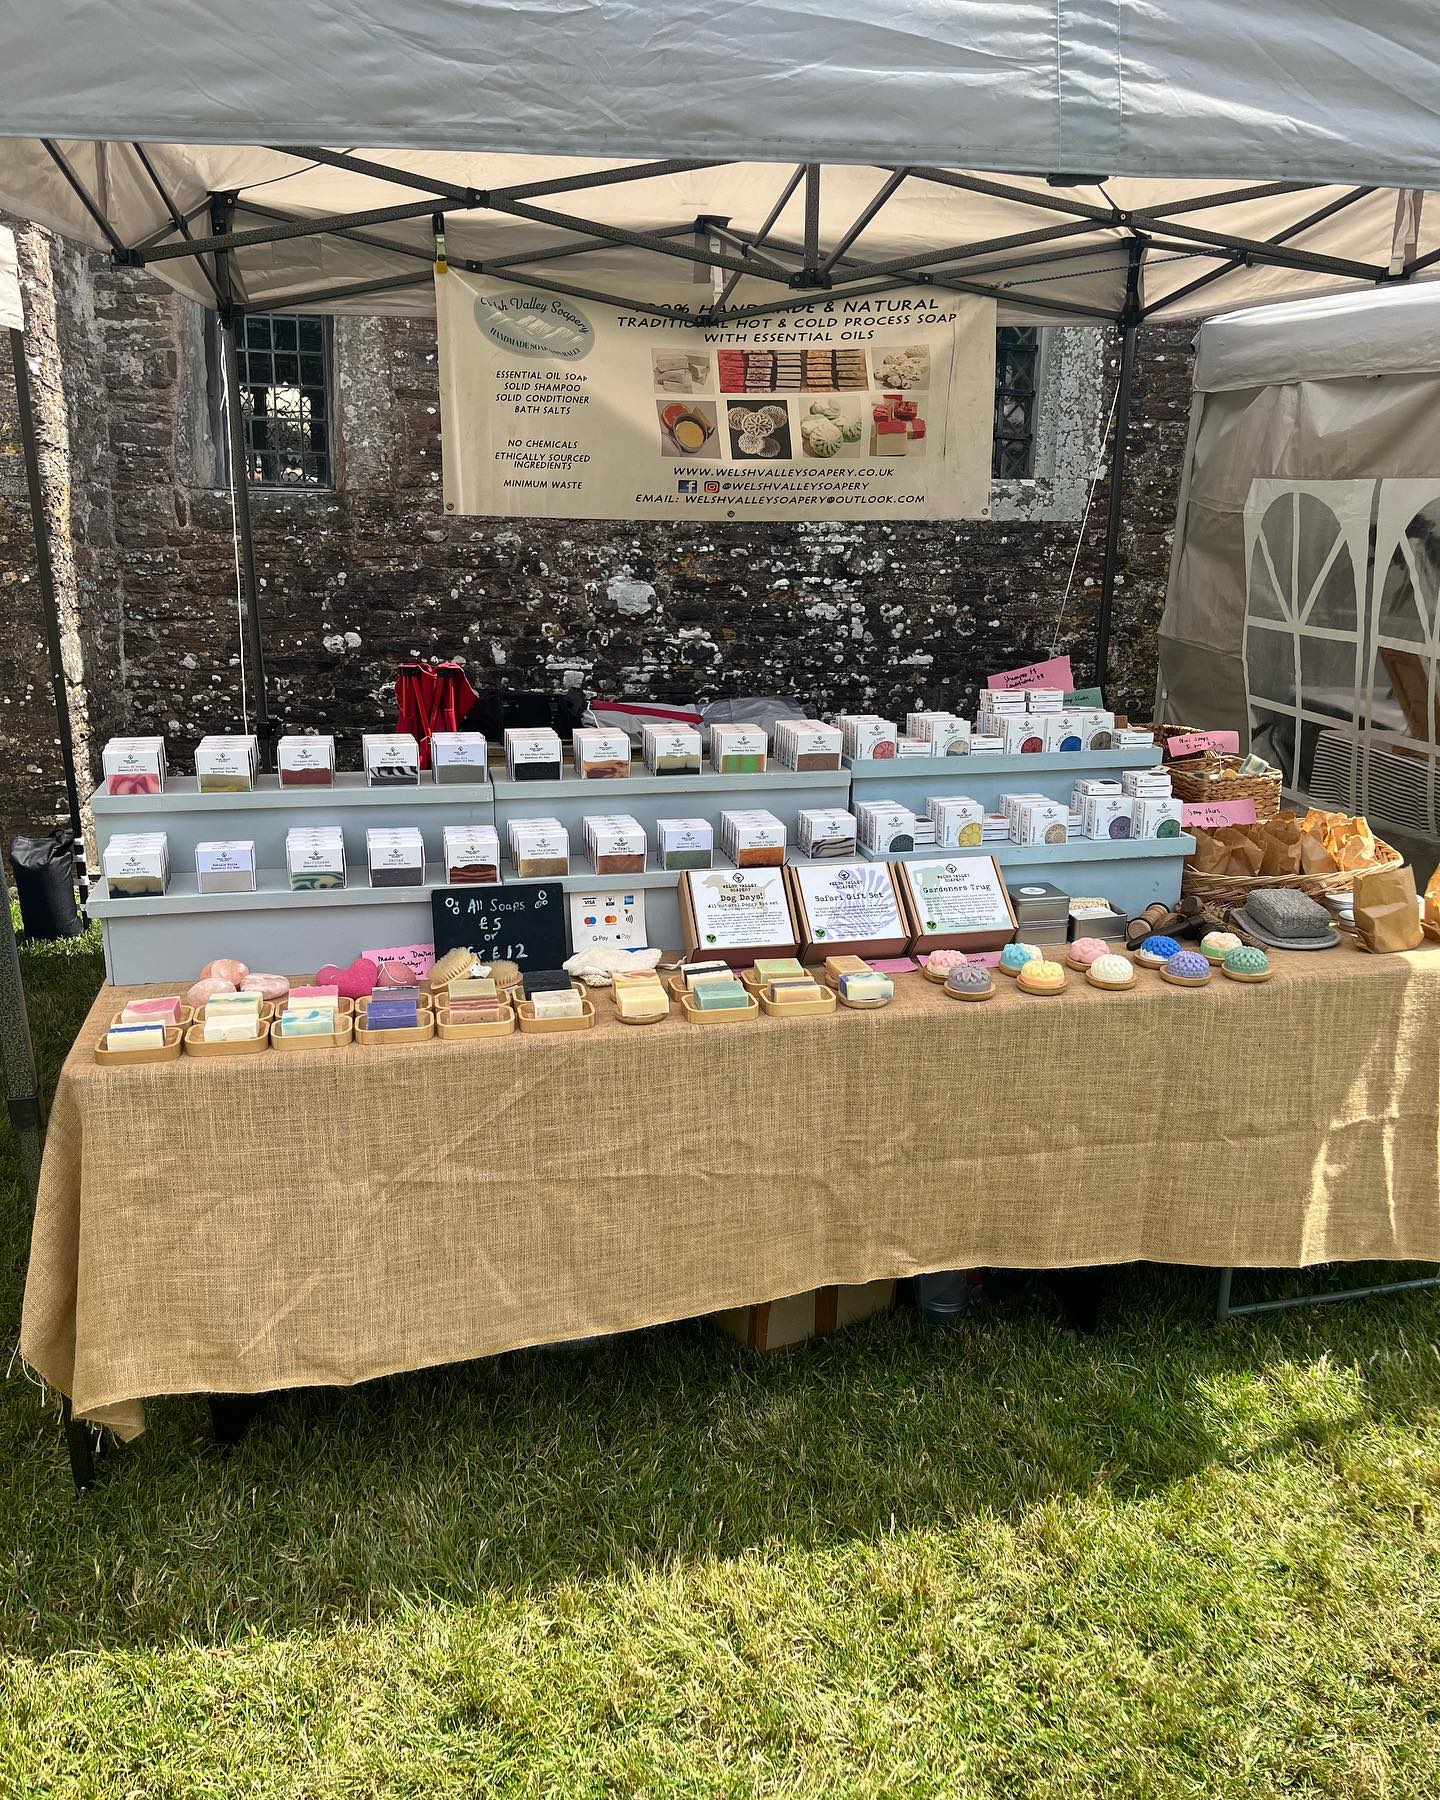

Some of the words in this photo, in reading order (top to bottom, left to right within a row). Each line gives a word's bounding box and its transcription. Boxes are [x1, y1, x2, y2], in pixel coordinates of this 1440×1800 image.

[824, 302, 835, 313] &
[843, 299, 938, 313] NATURAL
[510, 297, 548, 313] Valley
[551, 301, 589, 334] Soapery
[617, 317, 728, 328] TRADITIOAL
[736, 319, 772, 329] HOT
[778, 318, 787, 328] &
[794, 318, 838, 328] COLD
[844, 315, 911, 327] PROCESS
[917, 313, 957, 324] SOAP
[490, 327, 529, 349] HANDMADE
[704, 333, 748, 343] WITH
[753, 332, 833, 343] ESSENTIAL
[840, 330, 875, 340] OILS
[496, 370, 542, 380] ESSENTIAL
[545, 371, 561, 380] OIL
[564, 372, 588, 382] SOAP
[504, 382, 531, 391] SOLID
[534, 383, 581, 392] SHAMPOO
[495, 393, 522, 402] SOLID
[525, 394, 590, 404] CONDITIONER
[514, 405, 540, 413] BATH
[543, 406, 571, 415] SALTS
[507, 439, 523, 447] NO
[525, 440, 578, 449] CHEMICALS
[494, 452, 546, 461] ETHICALLY
[549, 453, 591, 463] SOURCED
[513, 461, 572, 470] INGREDIENTS
[673, 467, 895, 477] WWW.WELSHVALLEYSOAPERY.CO.UK
[503, 479, 548, 488] MINIMUM
[551, 481, 582, 490] WASTE
[722, 482, 870, 491] @WELSHVALLEYSOAPERY
[635, 494, 679, 503] EMAIL:
[685, 495, 926, 505] WELSHVALLEYSOAPERY@OUTLOOK.COM
[922, 886, 968, 894] Gardeners
[969, 883, 992, 892] Trug
[720, 895, 737, 903] Dog
[739, 892, 764, 902] Days!
[814, 894, 844, 902] Safari
[846, 892, 867, 901] Gift
[868, 891, 884, 899] Set
[467, 898, 483, 915] All
[490, 898, 526, 913] Soaps
[484, 930, 499, 942] or
[598, 934, 609, 942] Pay
